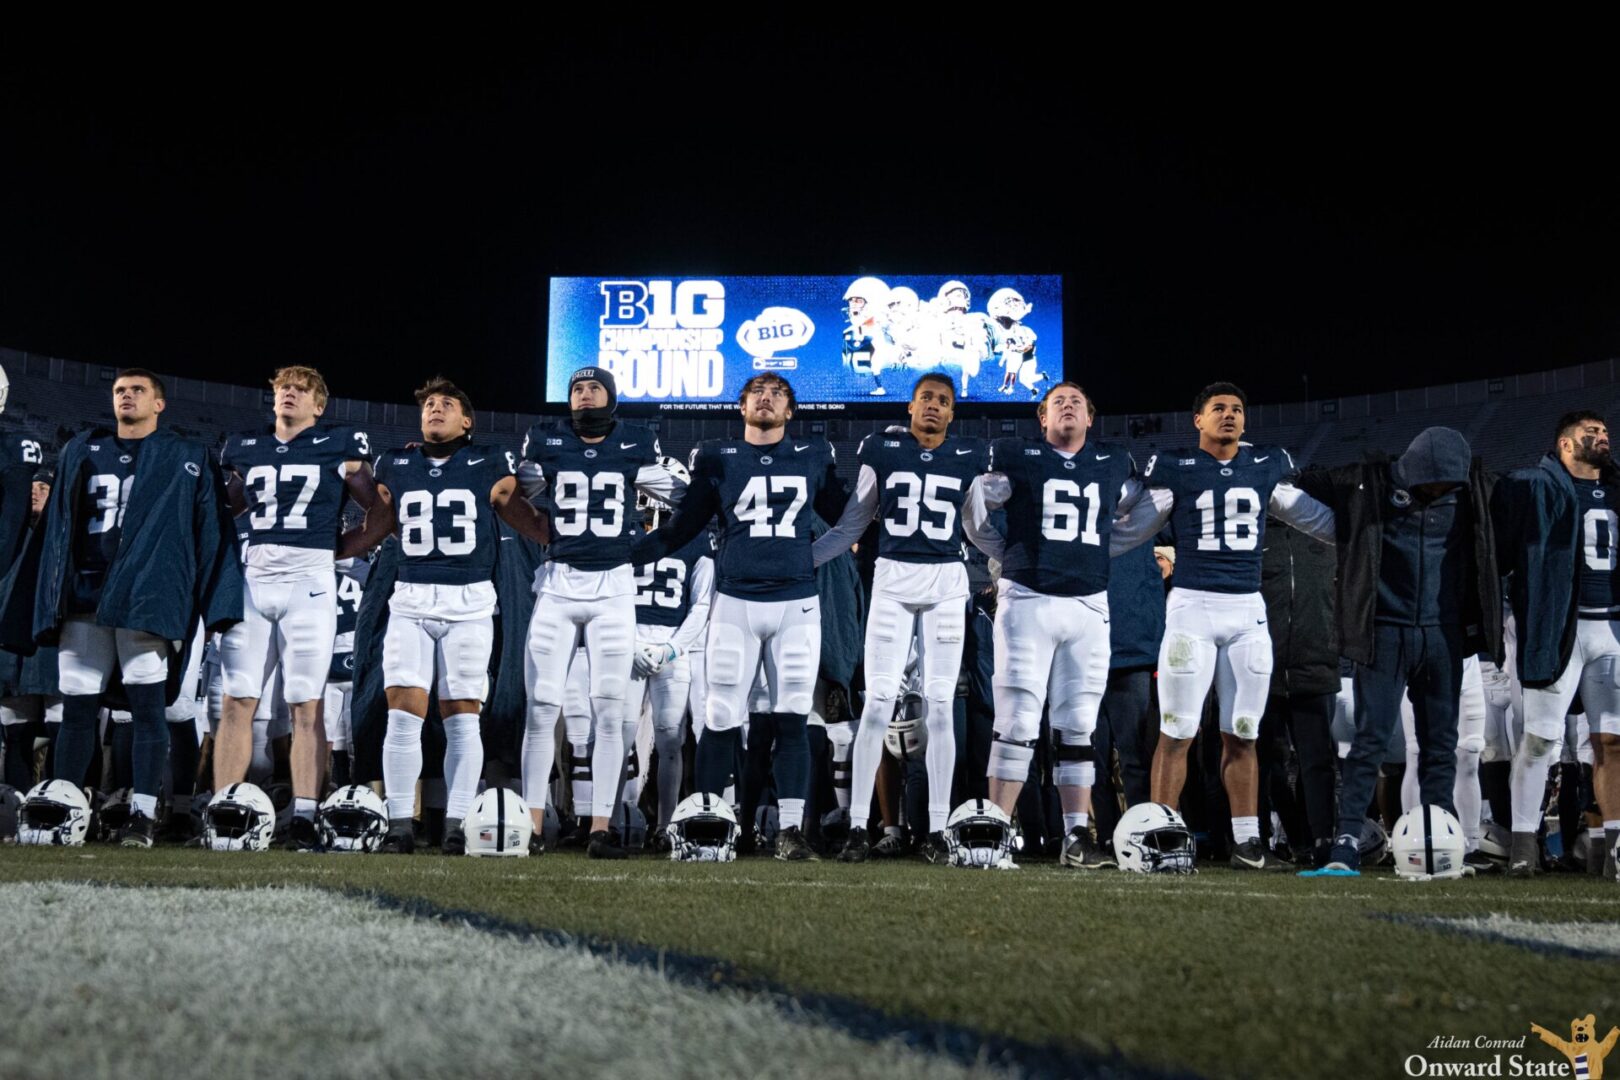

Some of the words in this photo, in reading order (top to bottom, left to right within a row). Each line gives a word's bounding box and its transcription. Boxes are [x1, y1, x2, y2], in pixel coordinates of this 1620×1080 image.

[246, 464, 320, 530] 37
[399, 488, 477, 556] 83
[555, 471, 625, 537] 93
[733, 476, 808, 538] 47
[884, 471, 962, 541] 35
[1041, 478, 1101, 546] 61
[1195, 487, 1262, 550] 18
[1583, 508, 1619, 570] 0
